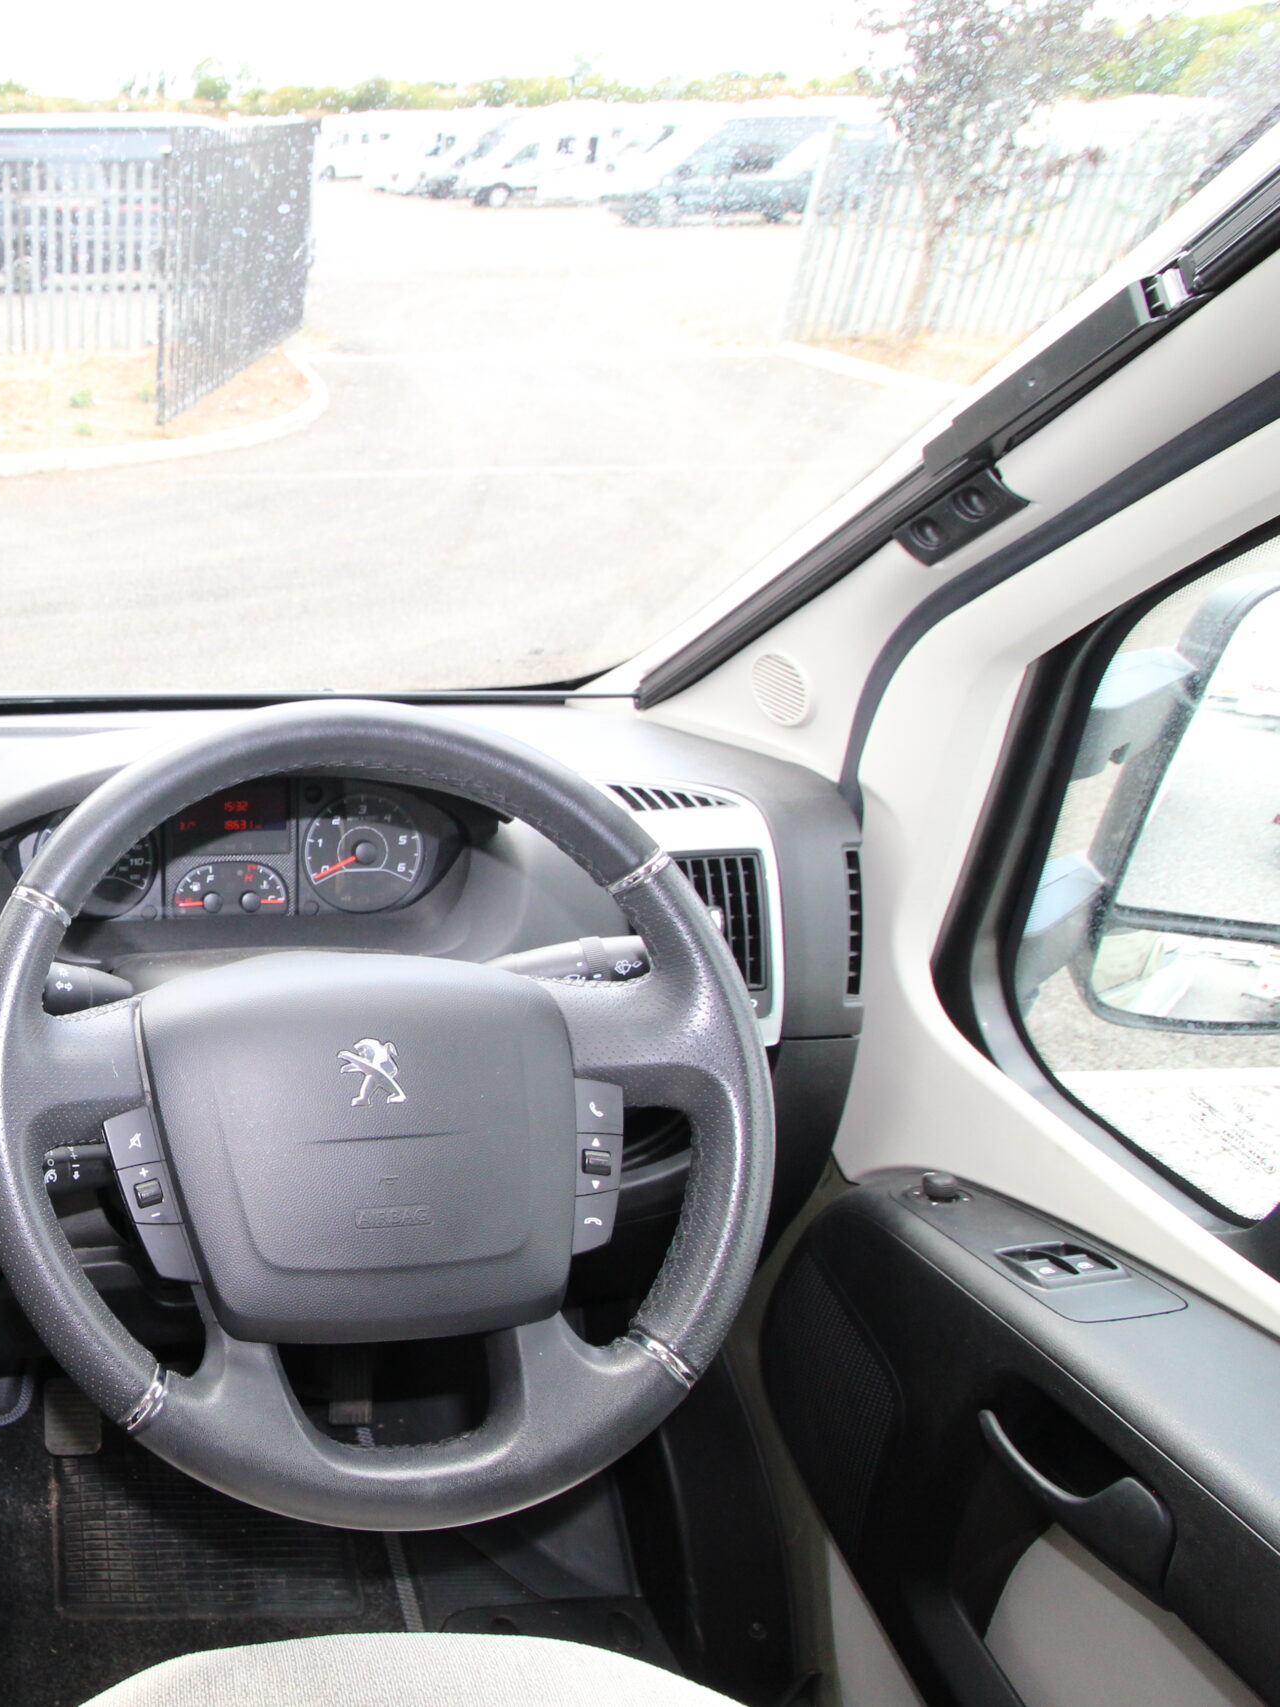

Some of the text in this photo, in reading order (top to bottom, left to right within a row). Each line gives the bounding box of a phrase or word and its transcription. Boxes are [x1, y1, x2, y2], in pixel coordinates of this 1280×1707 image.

[358, 804, 367, 814] 3
[331, 816, 341, 825] 2
[383, 815, 392, 823] 4
[317, 838, 324, 848] 1
[398, 835, 407, 845] 5
[130, 857, 145, 866] 110
[397, 862, 406, 872] 6
[358, 1206, 430, 1226] AIRBAG
